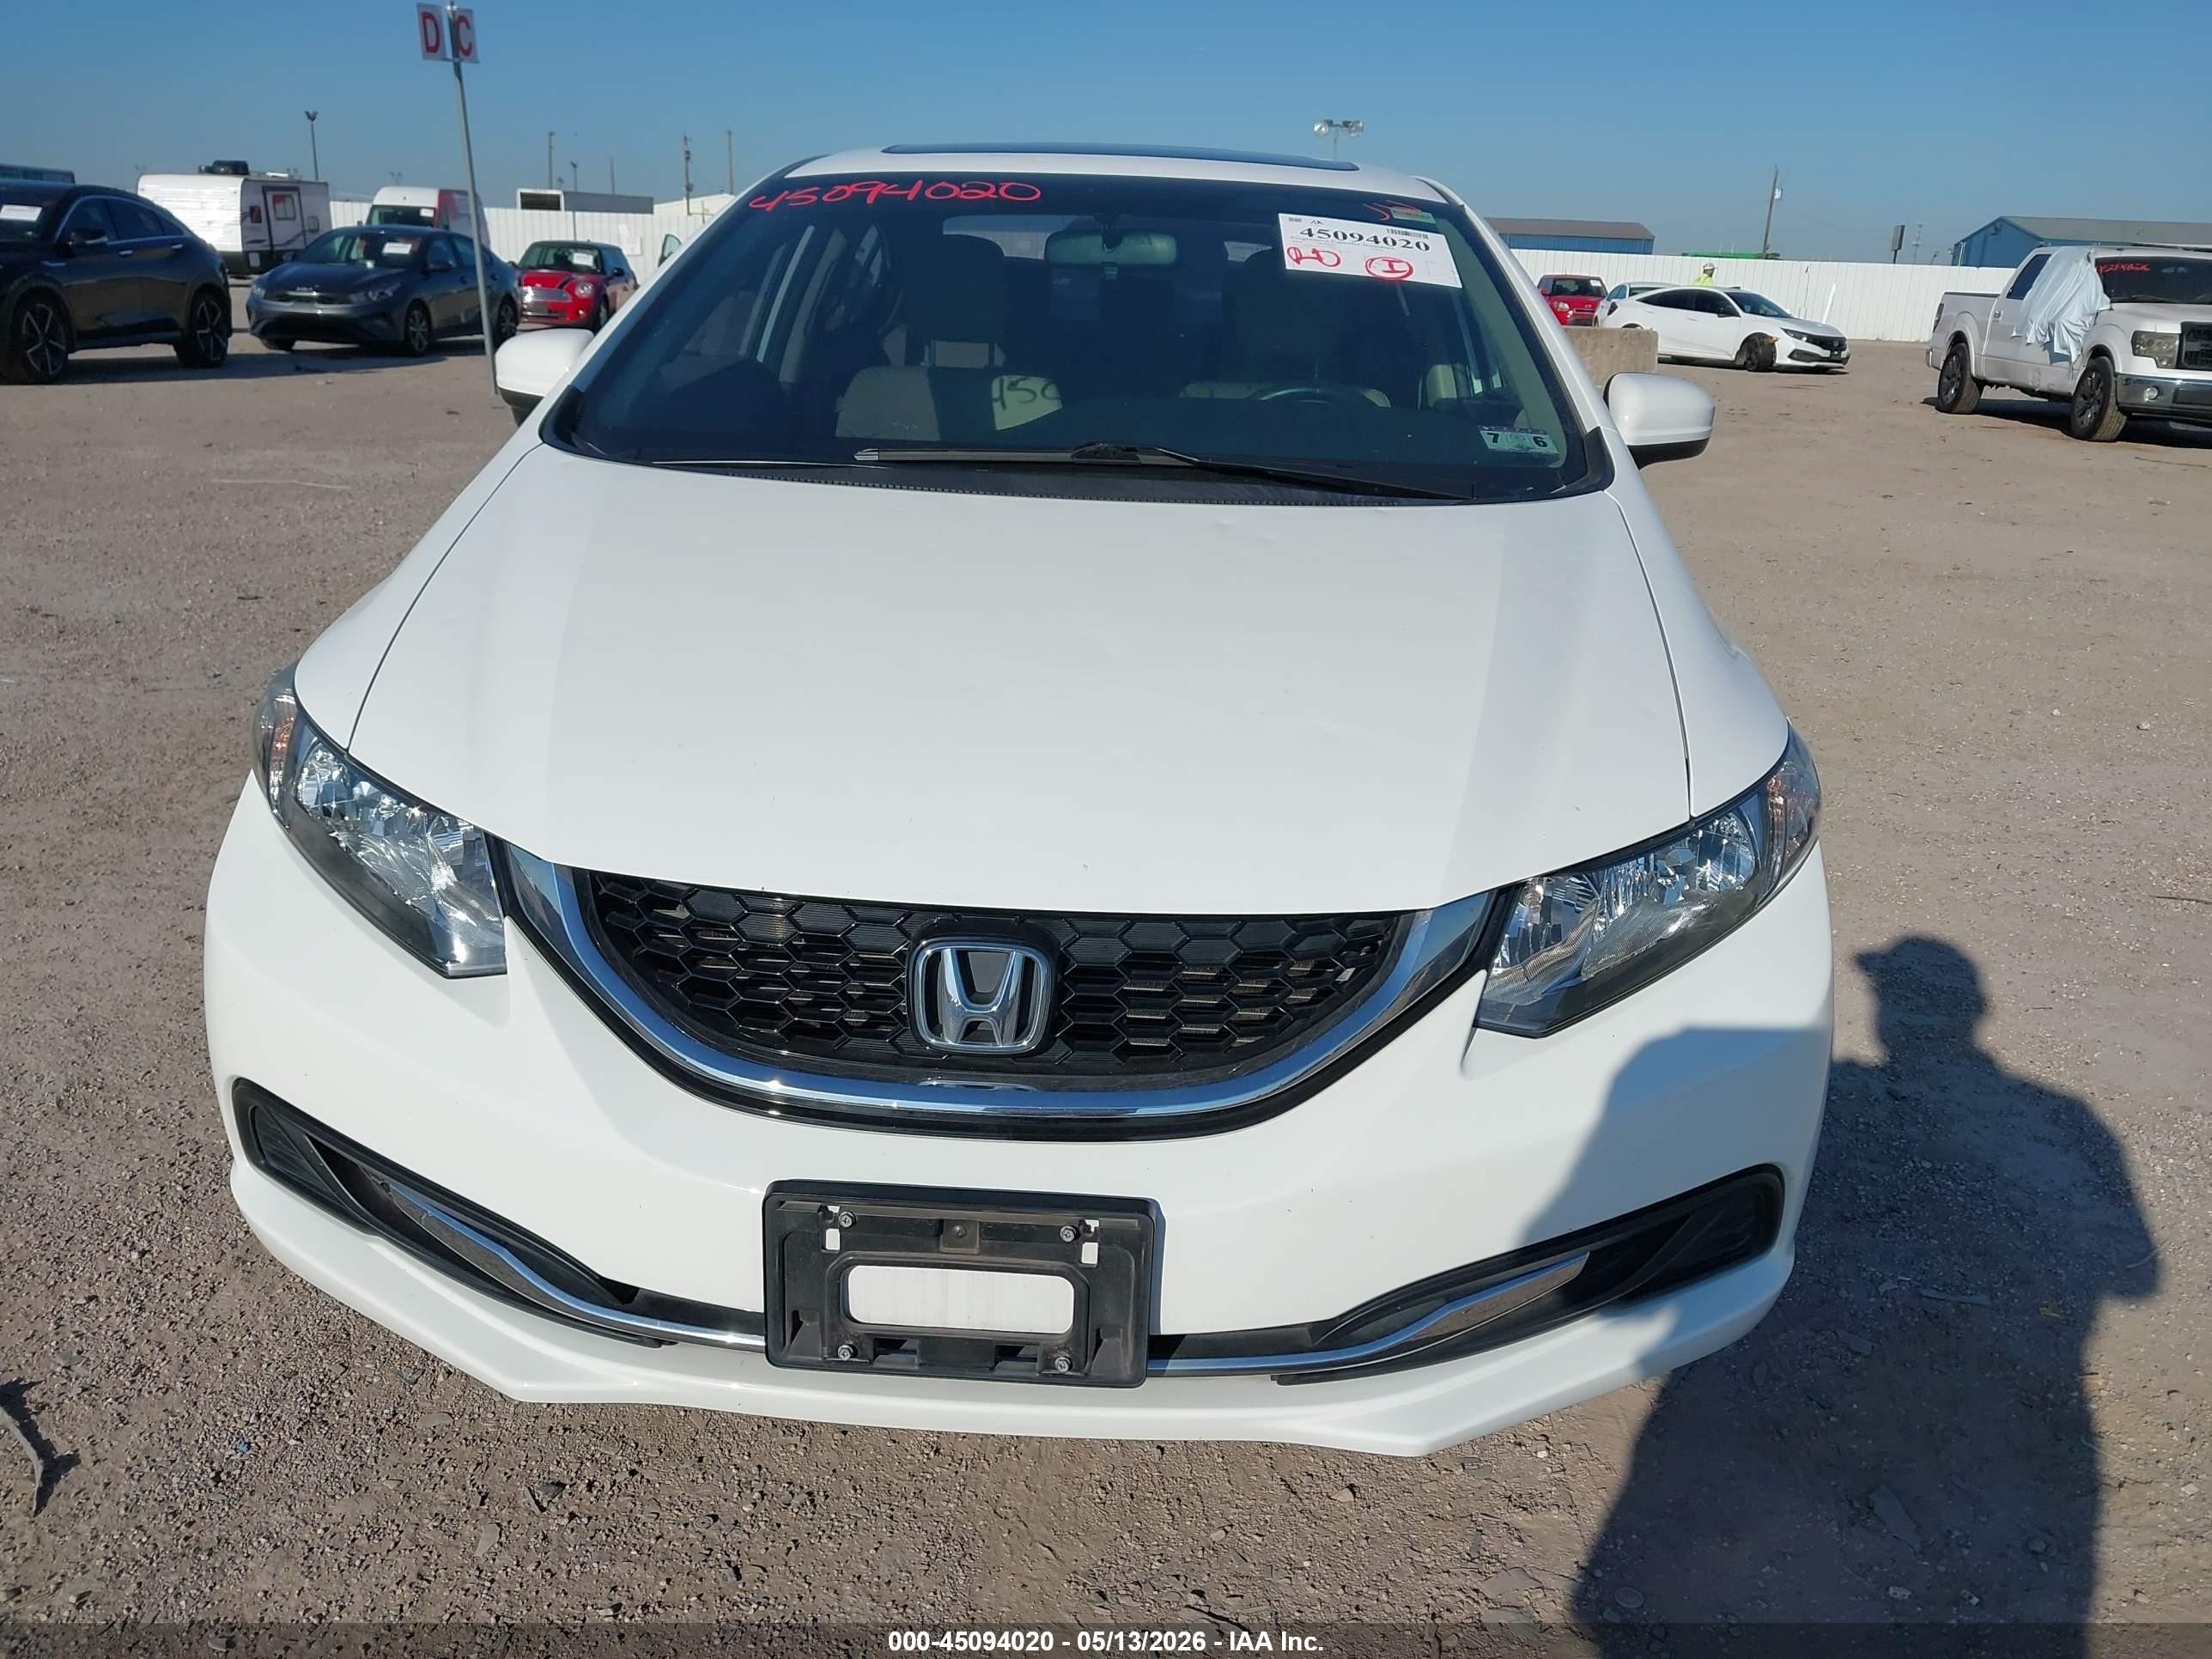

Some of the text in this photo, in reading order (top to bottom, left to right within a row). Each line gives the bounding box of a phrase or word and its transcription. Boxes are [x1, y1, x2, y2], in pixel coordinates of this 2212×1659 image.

[421, 11, 440, 53] D
[456, 15, 472, 56] C
[749, 179, 1041, 211] 45094020
[1299, 227, 1431, 252] 45094020
[1486, 432, 1548, 447] 7 6
